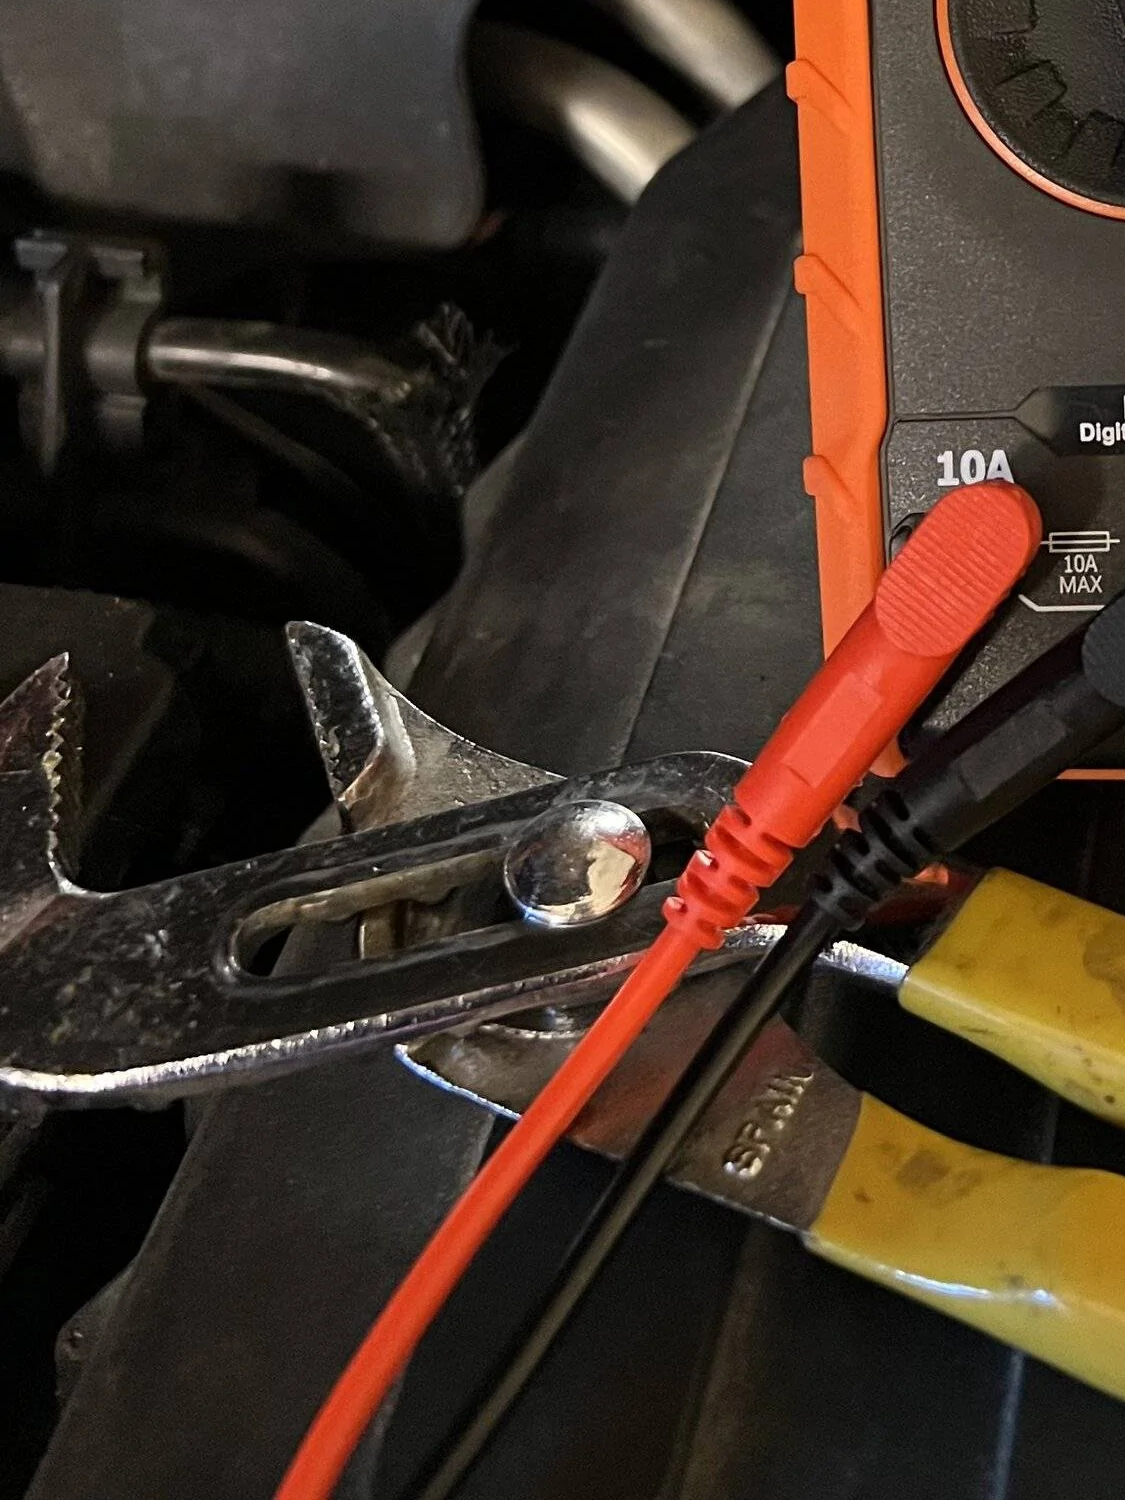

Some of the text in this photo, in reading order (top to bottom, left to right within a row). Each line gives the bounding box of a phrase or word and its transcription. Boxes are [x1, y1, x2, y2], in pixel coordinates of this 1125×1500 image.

[937, 450, 1014, 486] 10A
[1063, 555, 1098, 574] 10A
[1059, 576, 1103, 594] MAX
